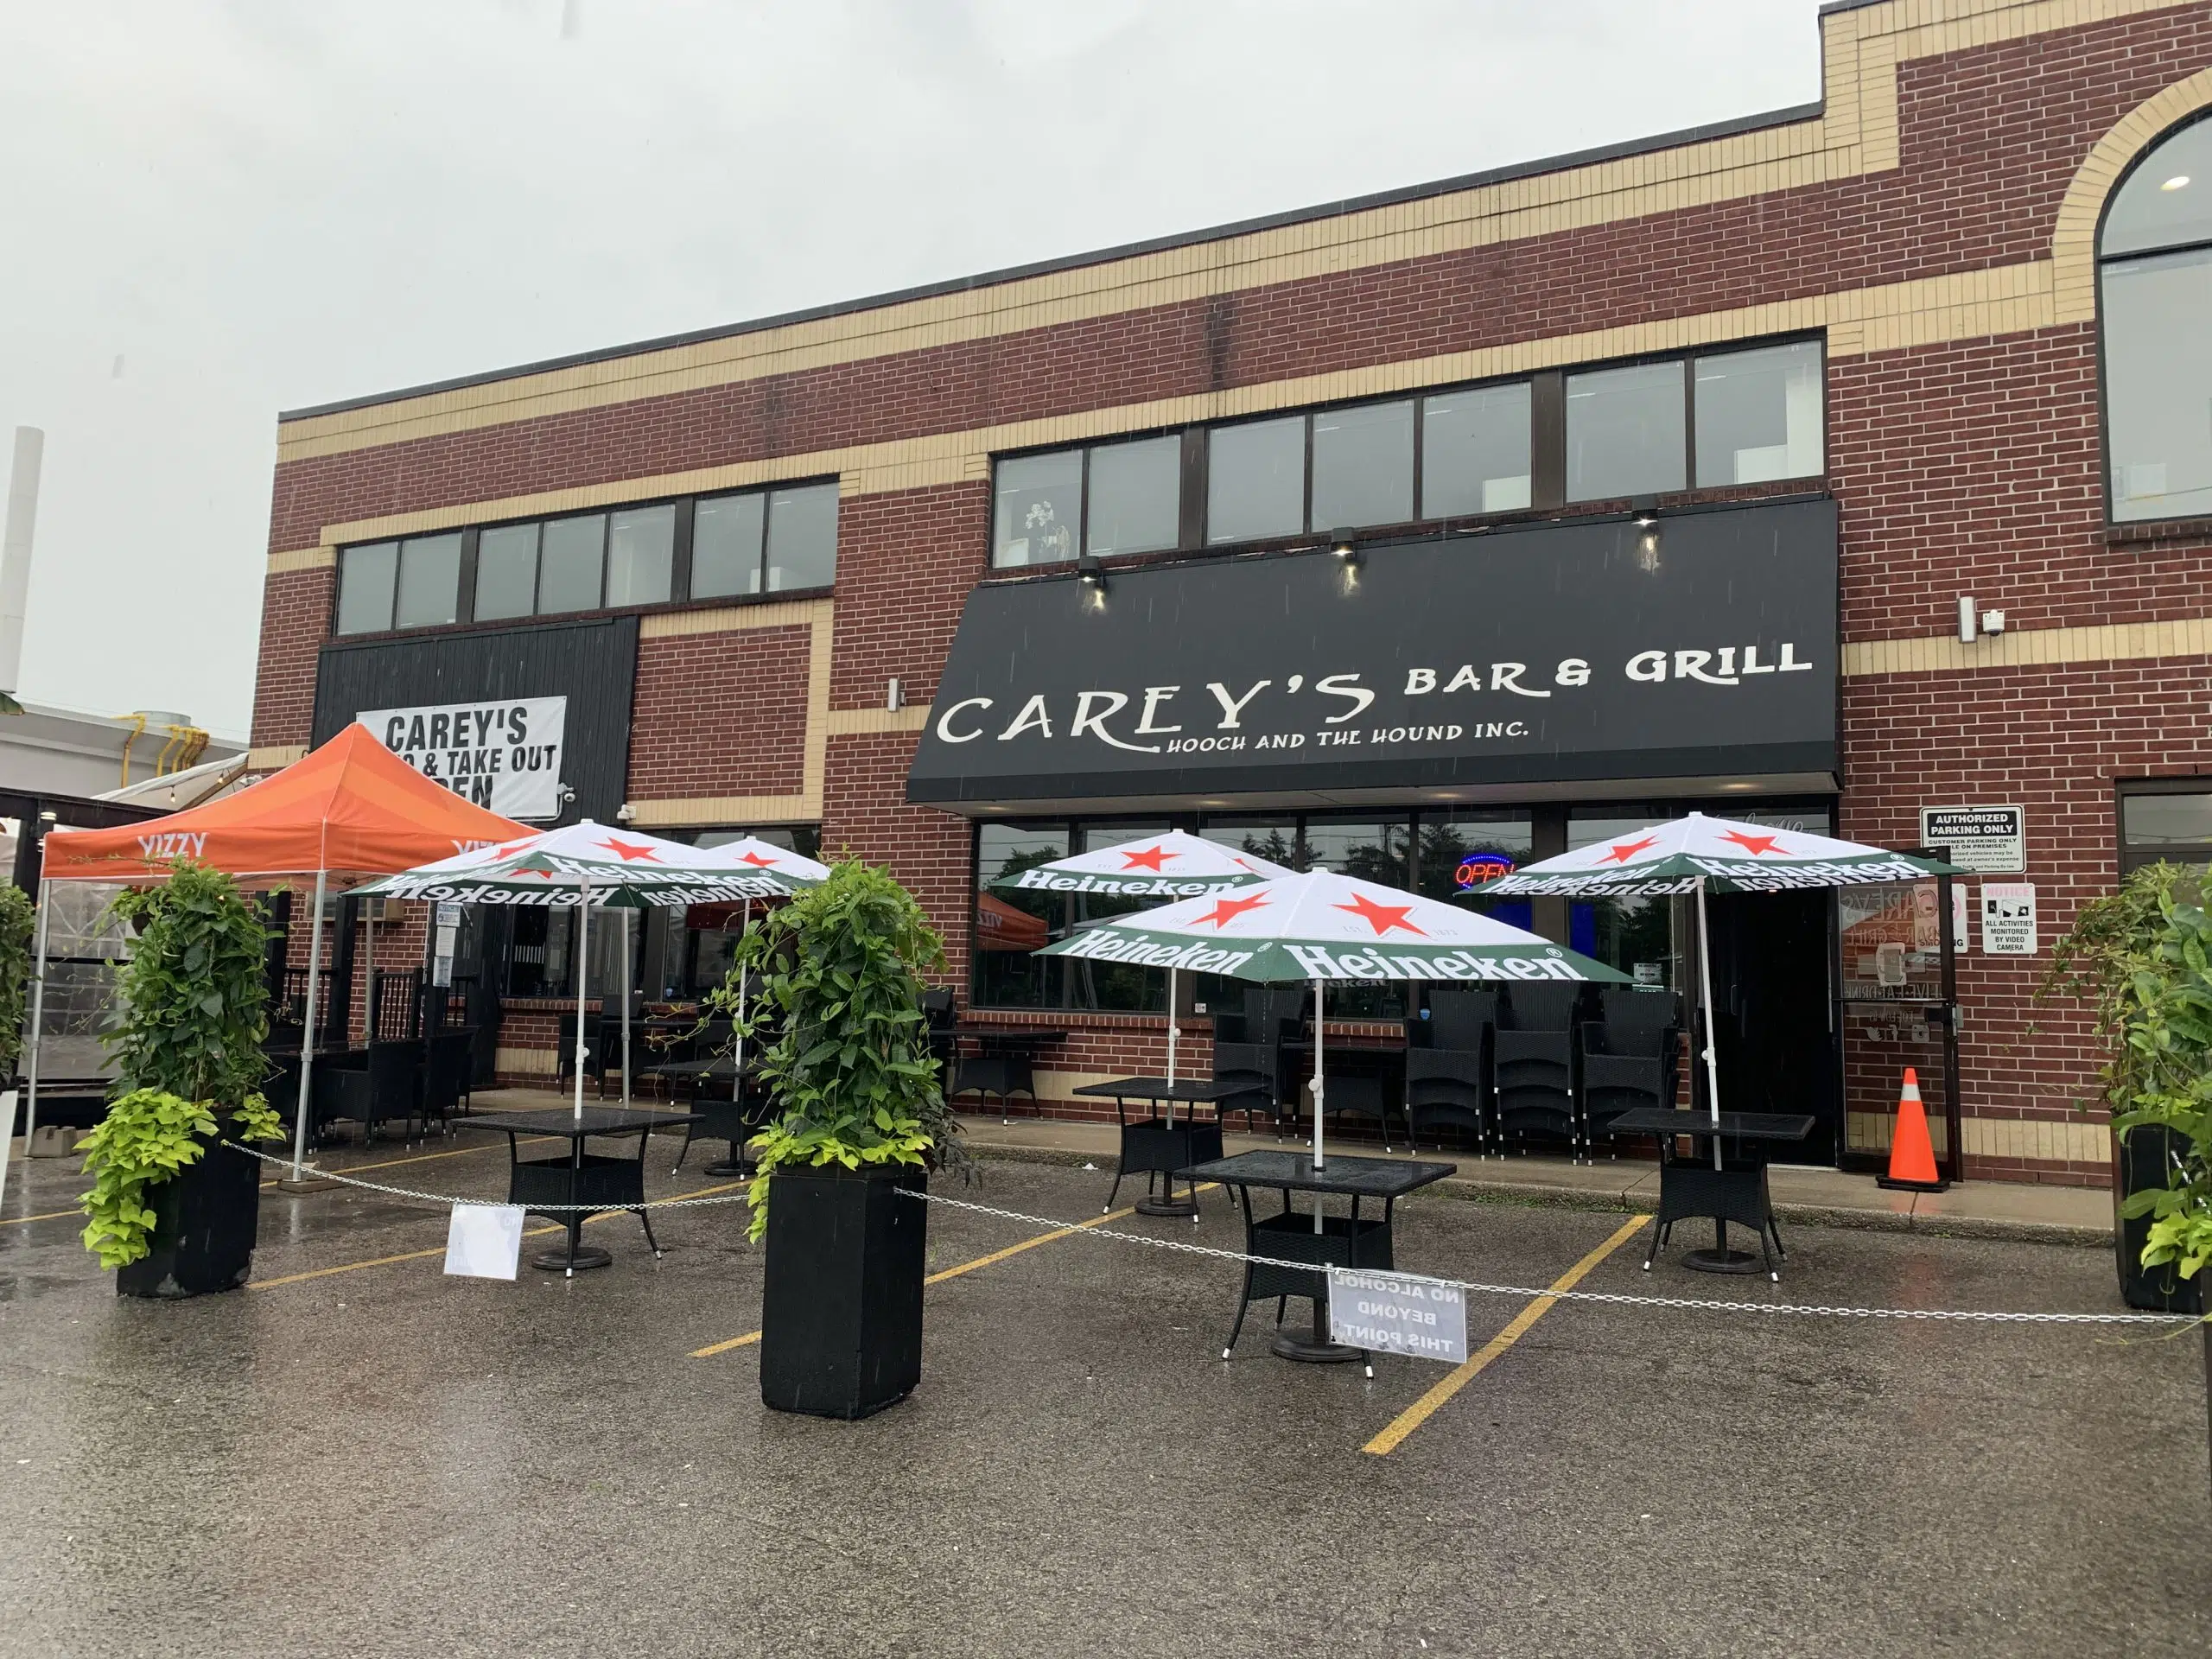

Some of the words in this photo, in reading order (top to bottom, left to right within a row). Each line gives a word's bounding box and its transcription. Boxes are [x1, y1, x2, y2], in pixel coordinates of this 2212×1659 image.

[937, 674, 1376, 753] CAREY'S
[1403, 662, 1552, 697] BAR
[1554, 658, 1592, 687] &
[1625, 642, 1813, 685] GRILL
[385, 707, 528, 752] CAREY'S
[1166, 734, 1246, 753] HOOCH
[1254, 733, 1306, 750] AND
[1317, 730, 1361, 746] THE
[1370, 724, 1464, 743] HOUND
[1474, 720, 1529, 738] INC.
[423, 753, 438, 778] &
[447, 748, 503, 776] TAKE
[512, 745, 557, 772] OUT
[1930, 825, 1980, 836] PARKING
[1983, 824, 2014, 834] ONLY
[1936, 814, 2009, 824] AUTHORIZED
[137, 832, 209, 858] VIZZY
[542, 855, 795, 893] Heineken
[1456, 863, 1515, 884] OPEN
[1686, 856, 1930, 877] Heineken
[1014, 870, 1236, 896] Heineken
[1986, 887, 2030, 897] NOTICE
[1058, 929, 1254, 975] Heineken
[1920, 938, 1964, 947] SMONG
[1282, 944, 1589, 981] Heineken
